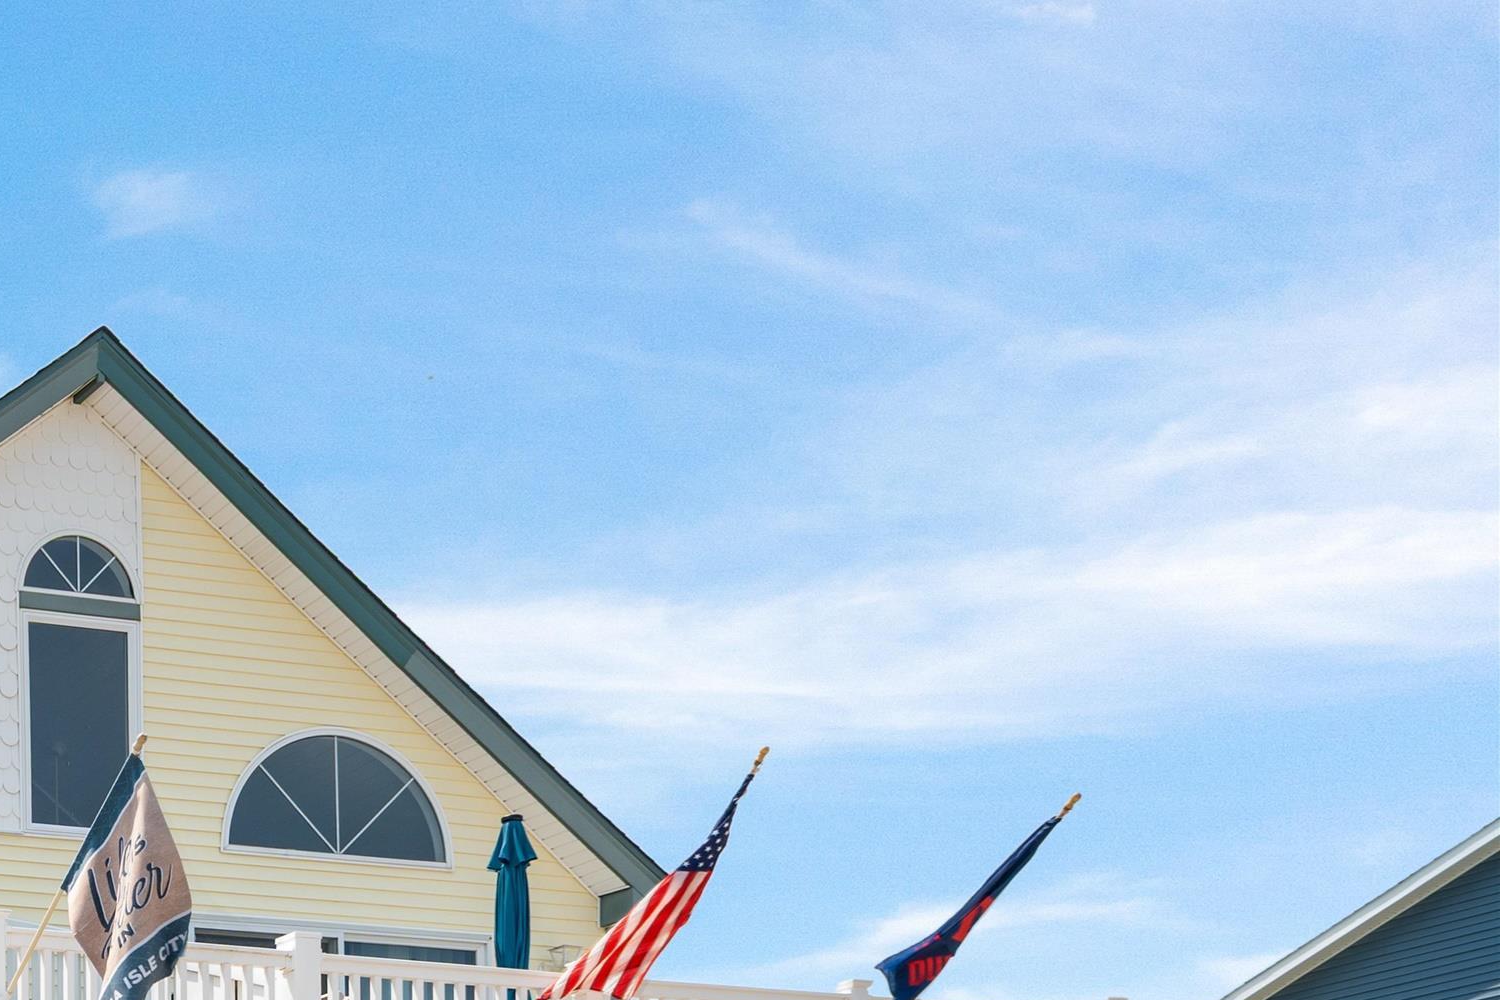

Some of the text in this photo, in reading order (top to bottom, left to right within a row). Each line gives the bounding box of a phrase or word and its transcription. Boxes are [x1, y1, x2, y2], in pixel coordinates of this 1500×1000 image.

[117, 922, 135, 949] IN
[122, 954, 159, 990] ISLE
[158, 928, 189, 962] CITY
